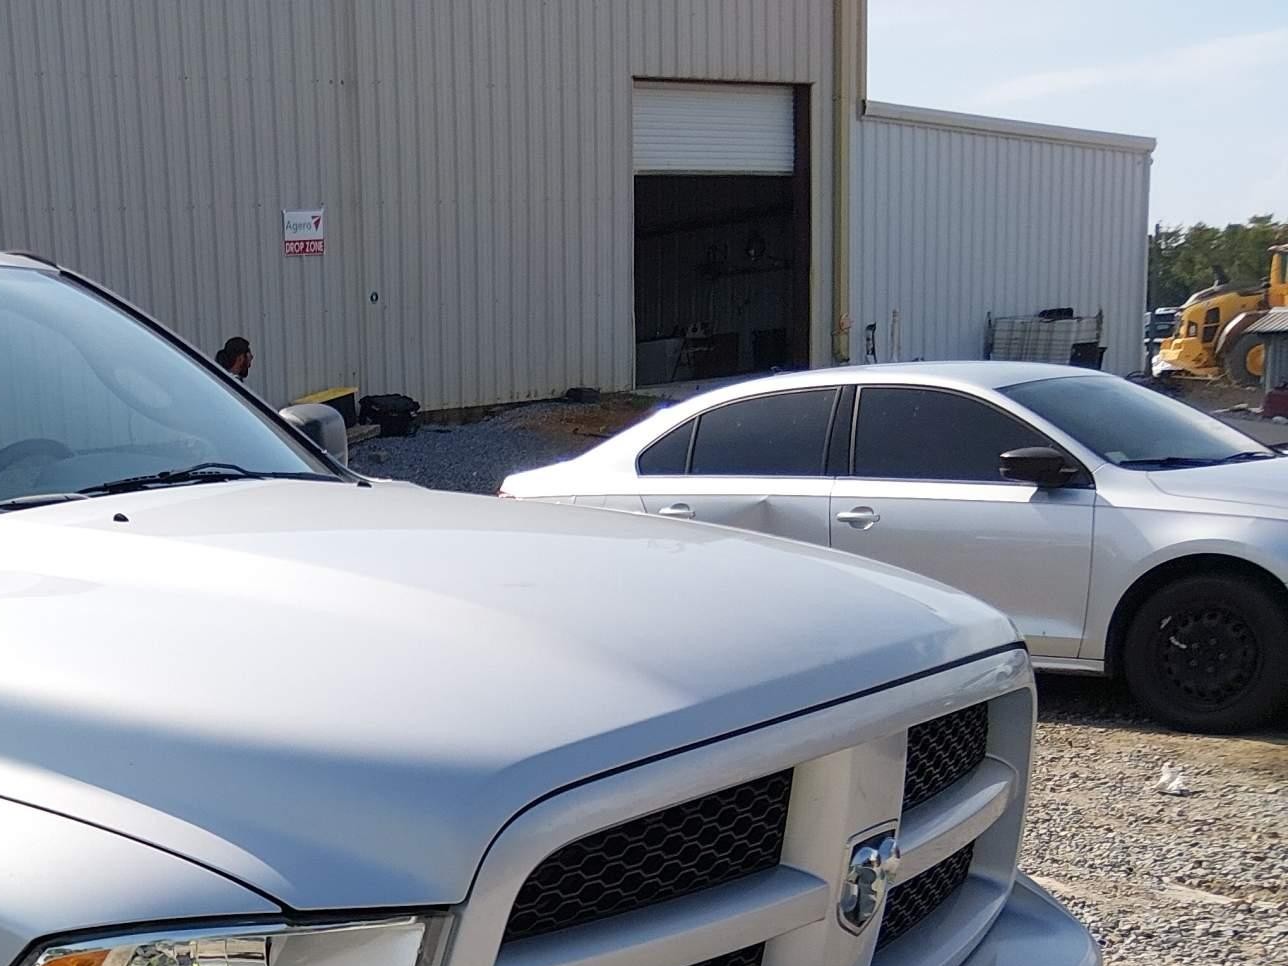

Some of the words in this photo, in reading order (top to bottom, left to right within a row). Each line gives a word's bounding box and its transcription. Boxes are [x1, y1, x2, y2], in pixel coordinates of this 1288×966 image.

[286, 220, 312, 233] Agero
[285, 241, 304, 253] DROP
[306, 241, 324, 252] ZONE
